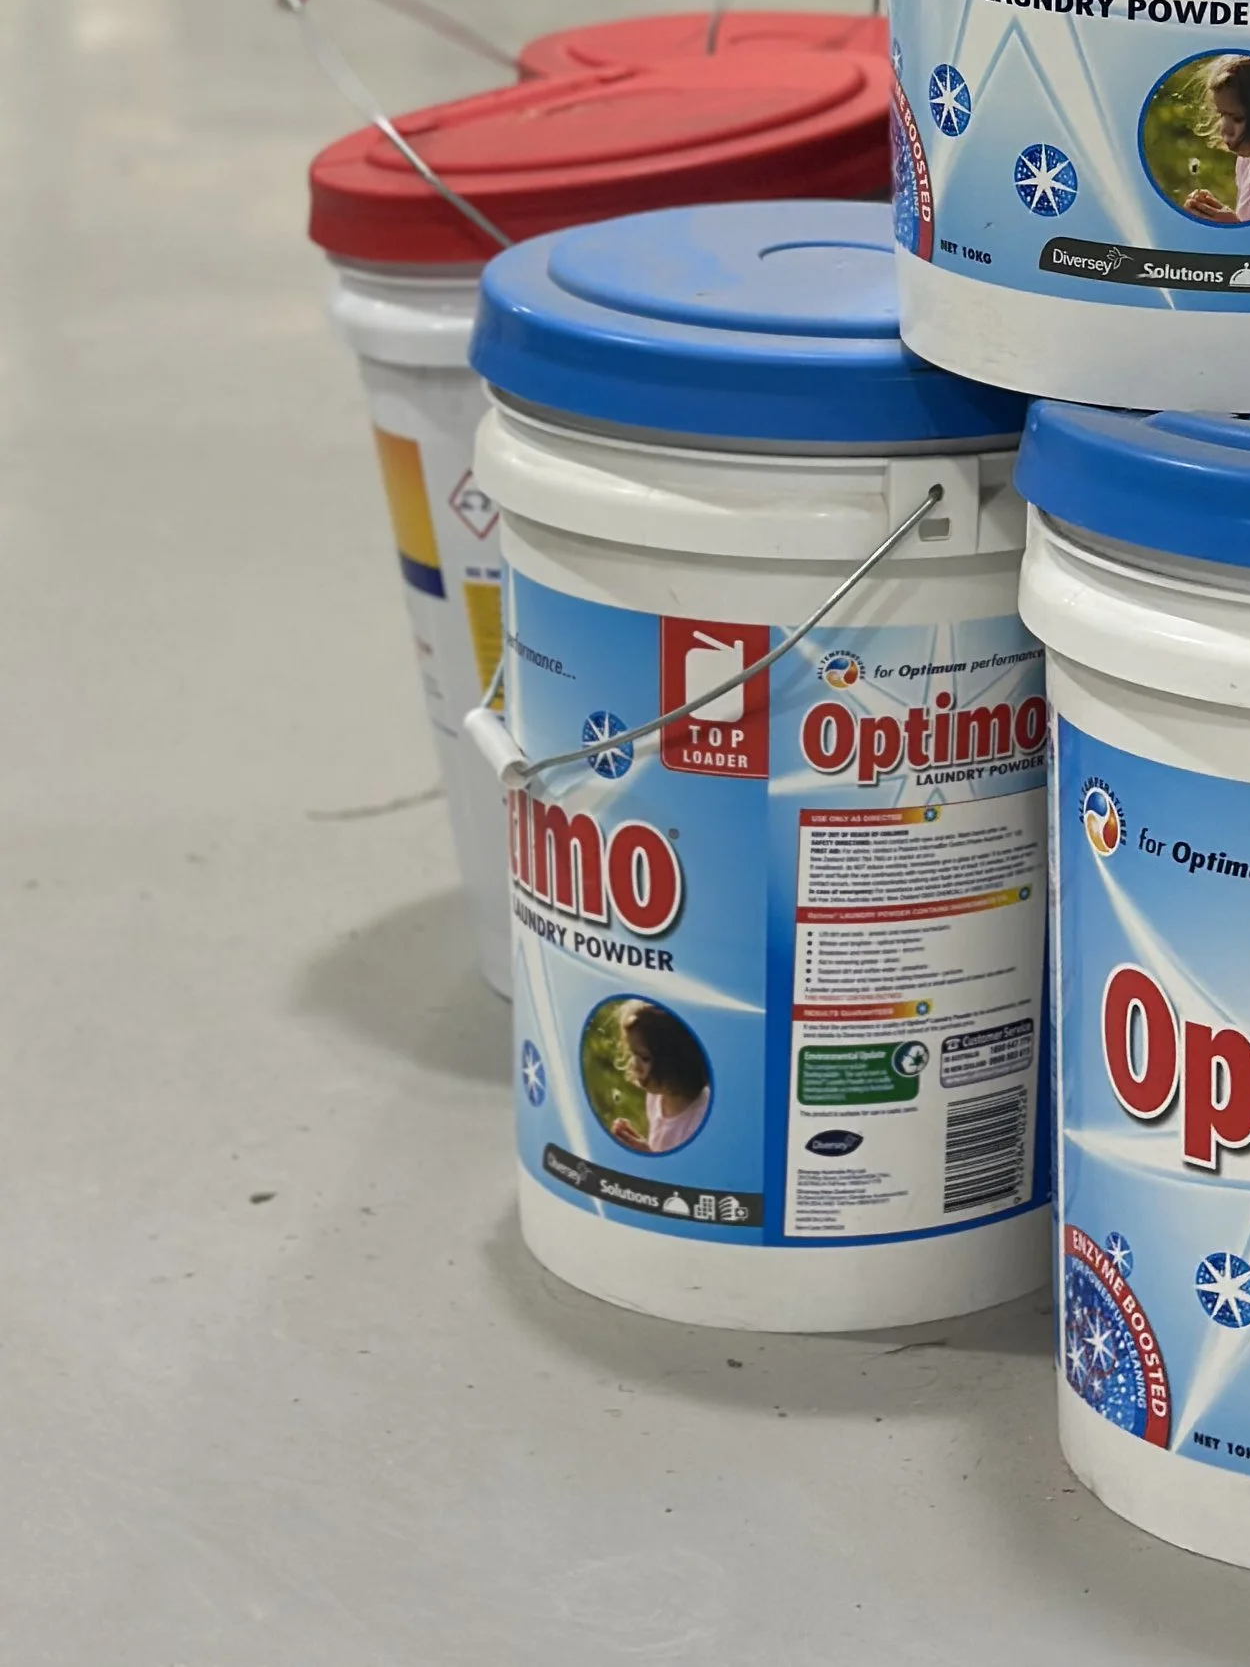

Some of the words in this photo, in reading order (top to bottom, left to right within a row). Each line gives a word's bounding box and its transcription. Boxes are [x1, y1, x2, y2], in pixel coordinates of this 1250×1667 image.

[940, 239, 957, 255] NET
[962, 243, 993, 265] 10KG
[1053, 248, 1113, 275] Diversey
[1142, 262, 1224, 283] Solutions
[874, 665, 894, 679] for
[898, 661, 967, 680] Optimum
[688, 725, 744, 748] TOP
[801, 691, 1047, 790] Optimo
[682, 749, 748, 769] LOADER
[916, 767, 985, 786] LAUNDRY
[989, 755, 1045, 777] POWDER
[1083, 776, 1127, 846] TEMPERATURES
[1138, 827, 1167, 857] for
[572, 930, 675, 972] POWDER
[600, 1178, 659, 1207] Solutions
[1072, 1230, 1123, 1297] ENZYME
[1121, 1295, 1167, 1418] BOOSTED
[1193, 1432, 1221, 1451] NET
